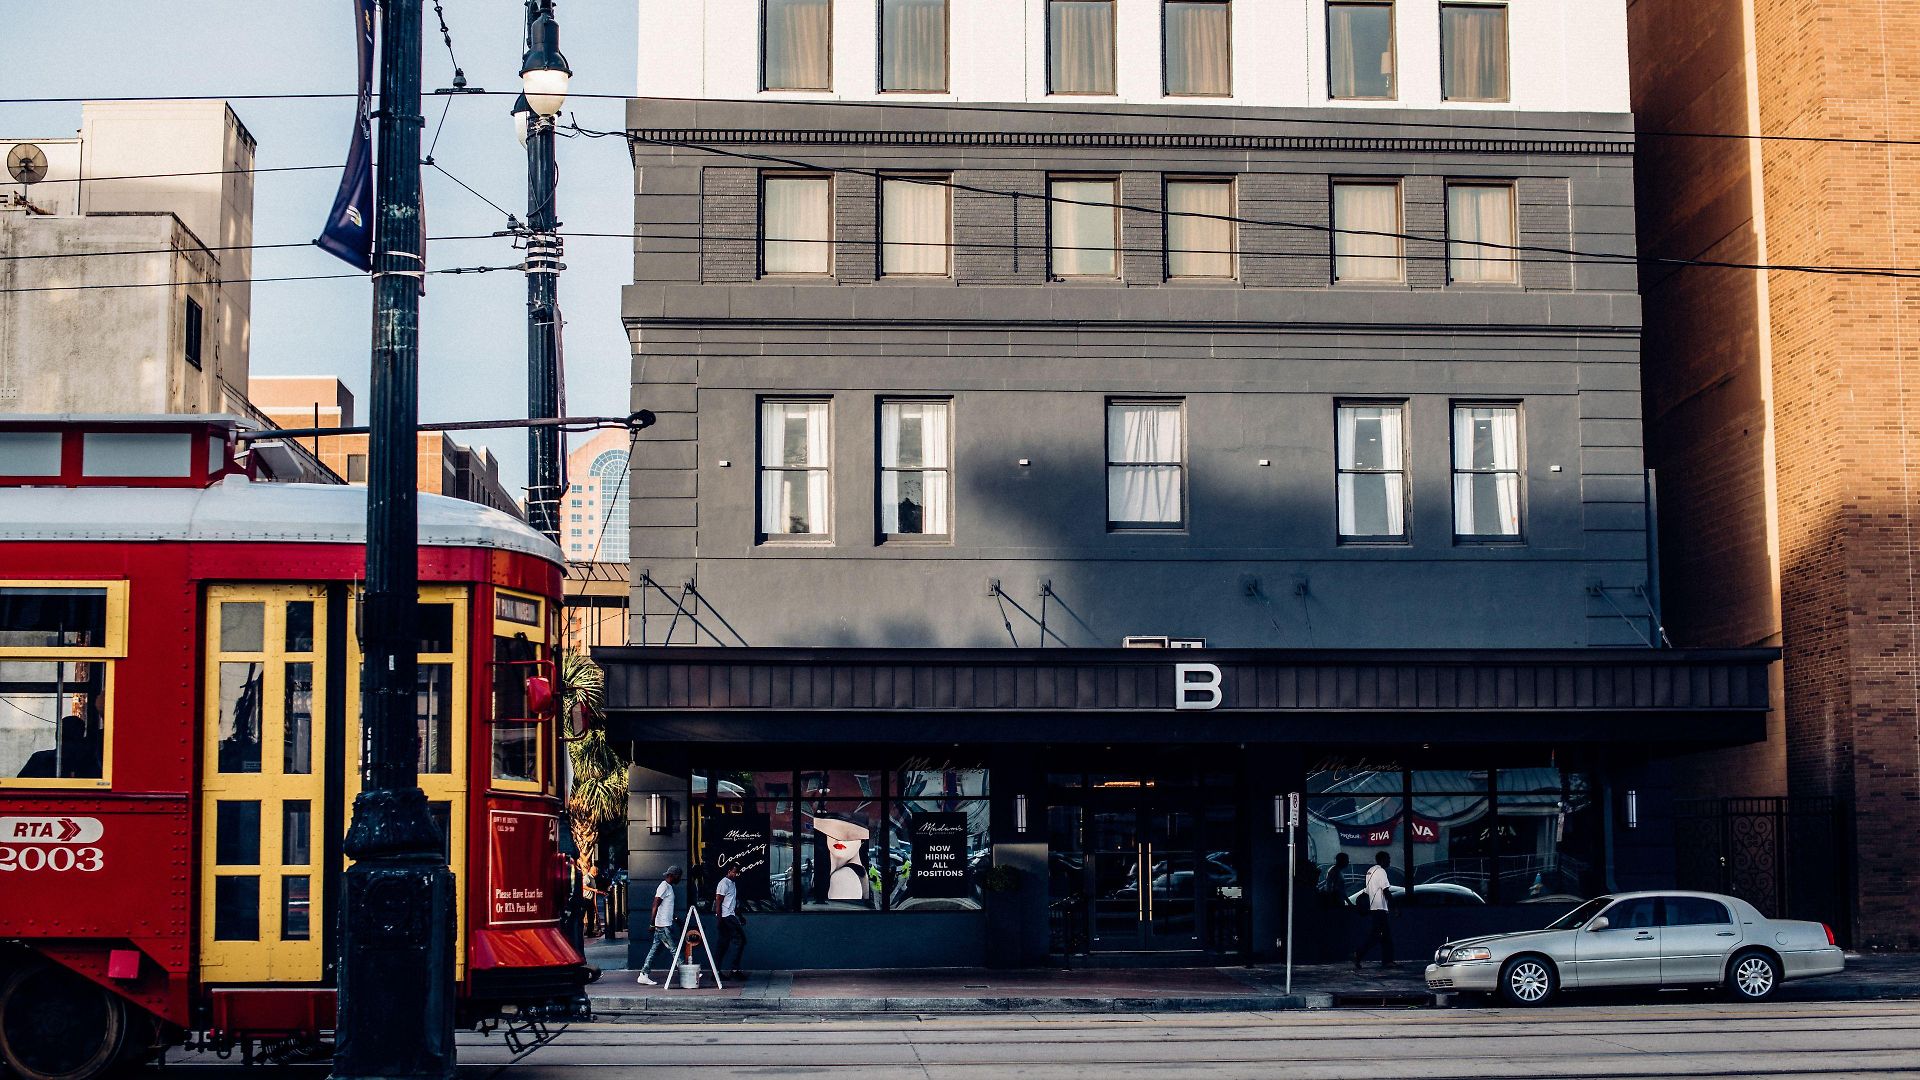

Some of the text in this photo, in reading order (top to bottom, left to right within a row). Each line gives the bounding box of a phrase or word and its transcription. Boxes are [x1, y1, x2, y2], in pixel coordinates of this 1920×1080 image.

[1175, 663, 1222, 709] B
[13, 822, 53, 837] RTA
[0, 846, 104, 872] 2003
[717, 843, 767, 868] Coming
[932, 861, 949, 869] ALL
[495, 888, 511, 899] Please
[512, 888, 524, 899] Have
[524, 888, 536, 899] Exact
[495, 902, 504, 914] Or
[504, 902, 516, 913] RTA
[516, 902, 526, 913] Pass
